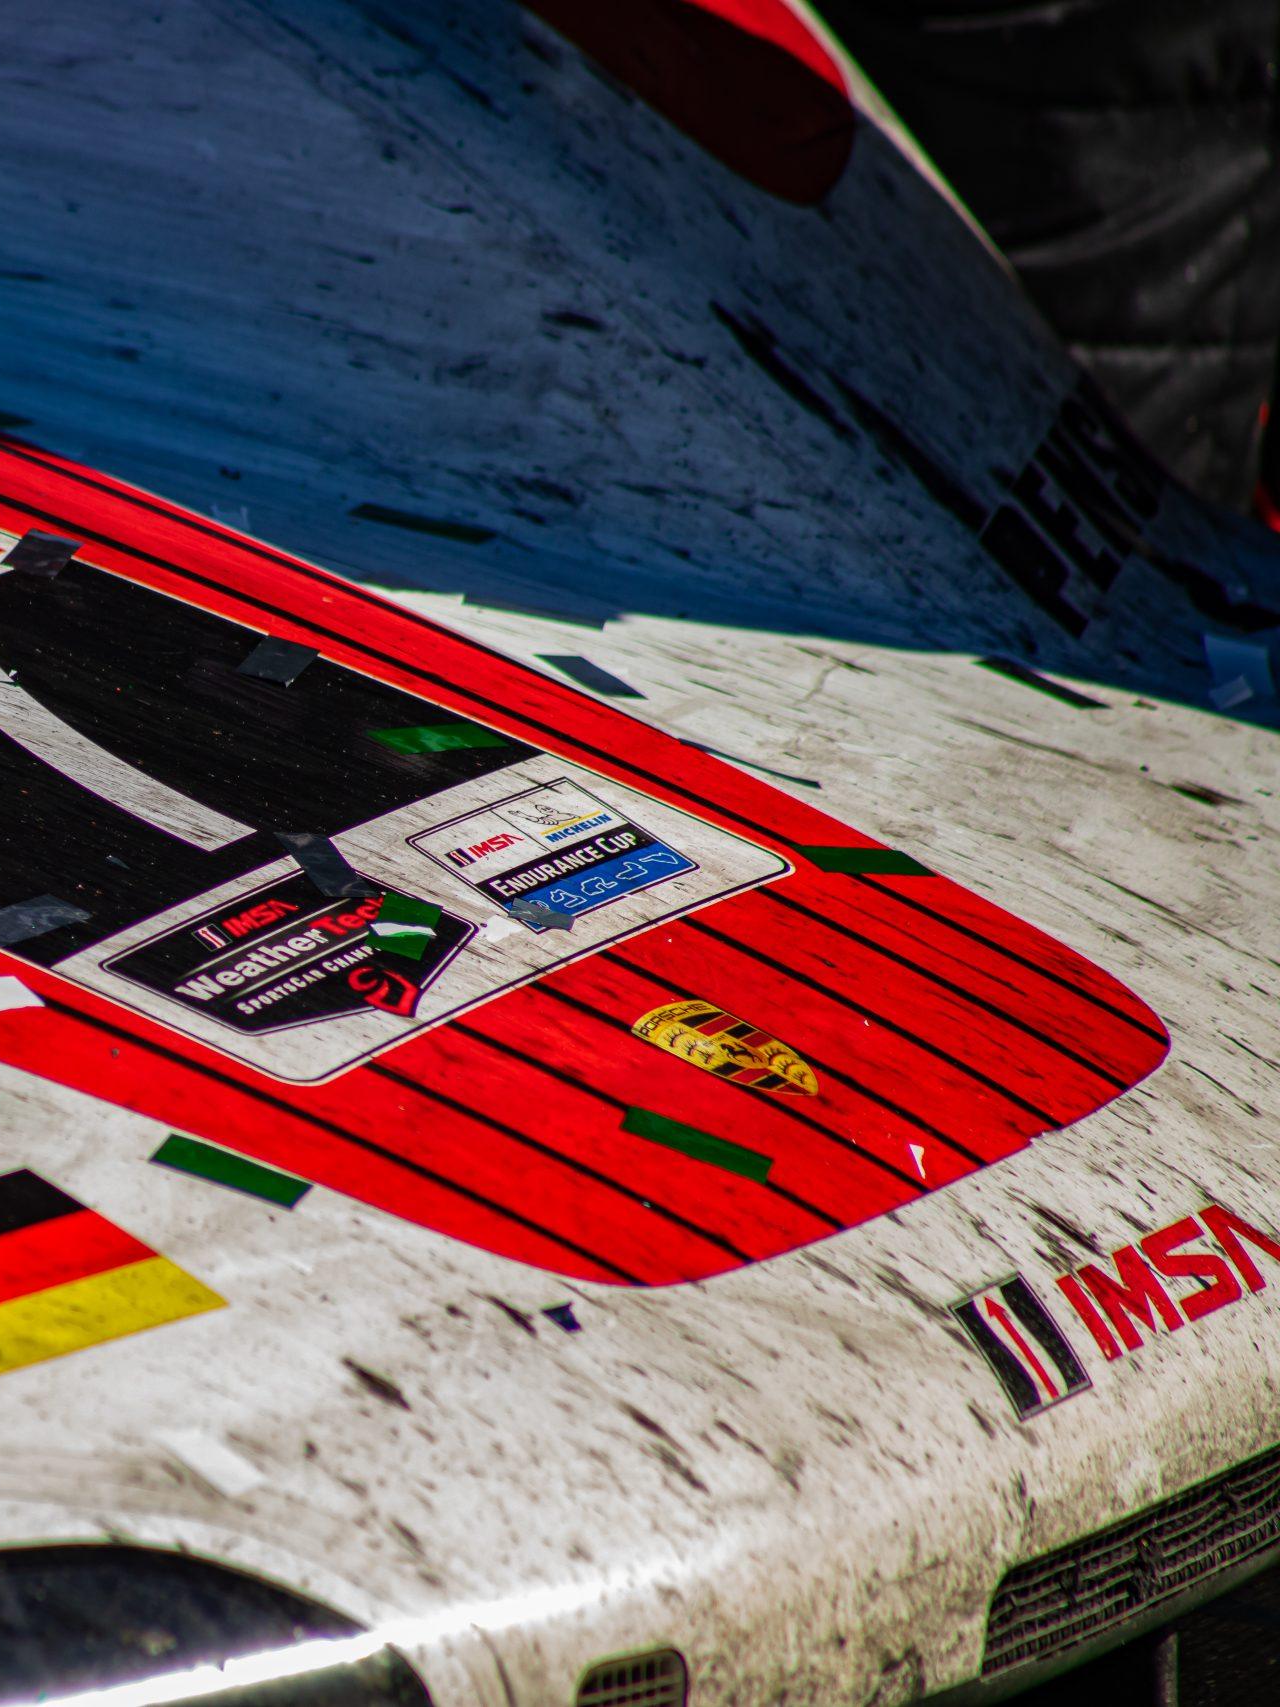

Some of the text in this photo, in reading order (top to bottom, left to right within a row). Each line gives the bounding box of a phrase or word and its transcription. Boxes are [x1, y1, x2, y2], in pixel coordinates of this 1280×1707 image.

[979, 378, 1166, 637] PENS
[545, 812, 613, 843] MICHELIN
[468, 832, 524, 859] IMSA
[221, 898, 300, 938] IMSA
[322, 945, 382, 972] CHAMP
[638, 1003, 711, 1037] PORSCHE
[1055, 1204, 1280, 1362] IMSA
